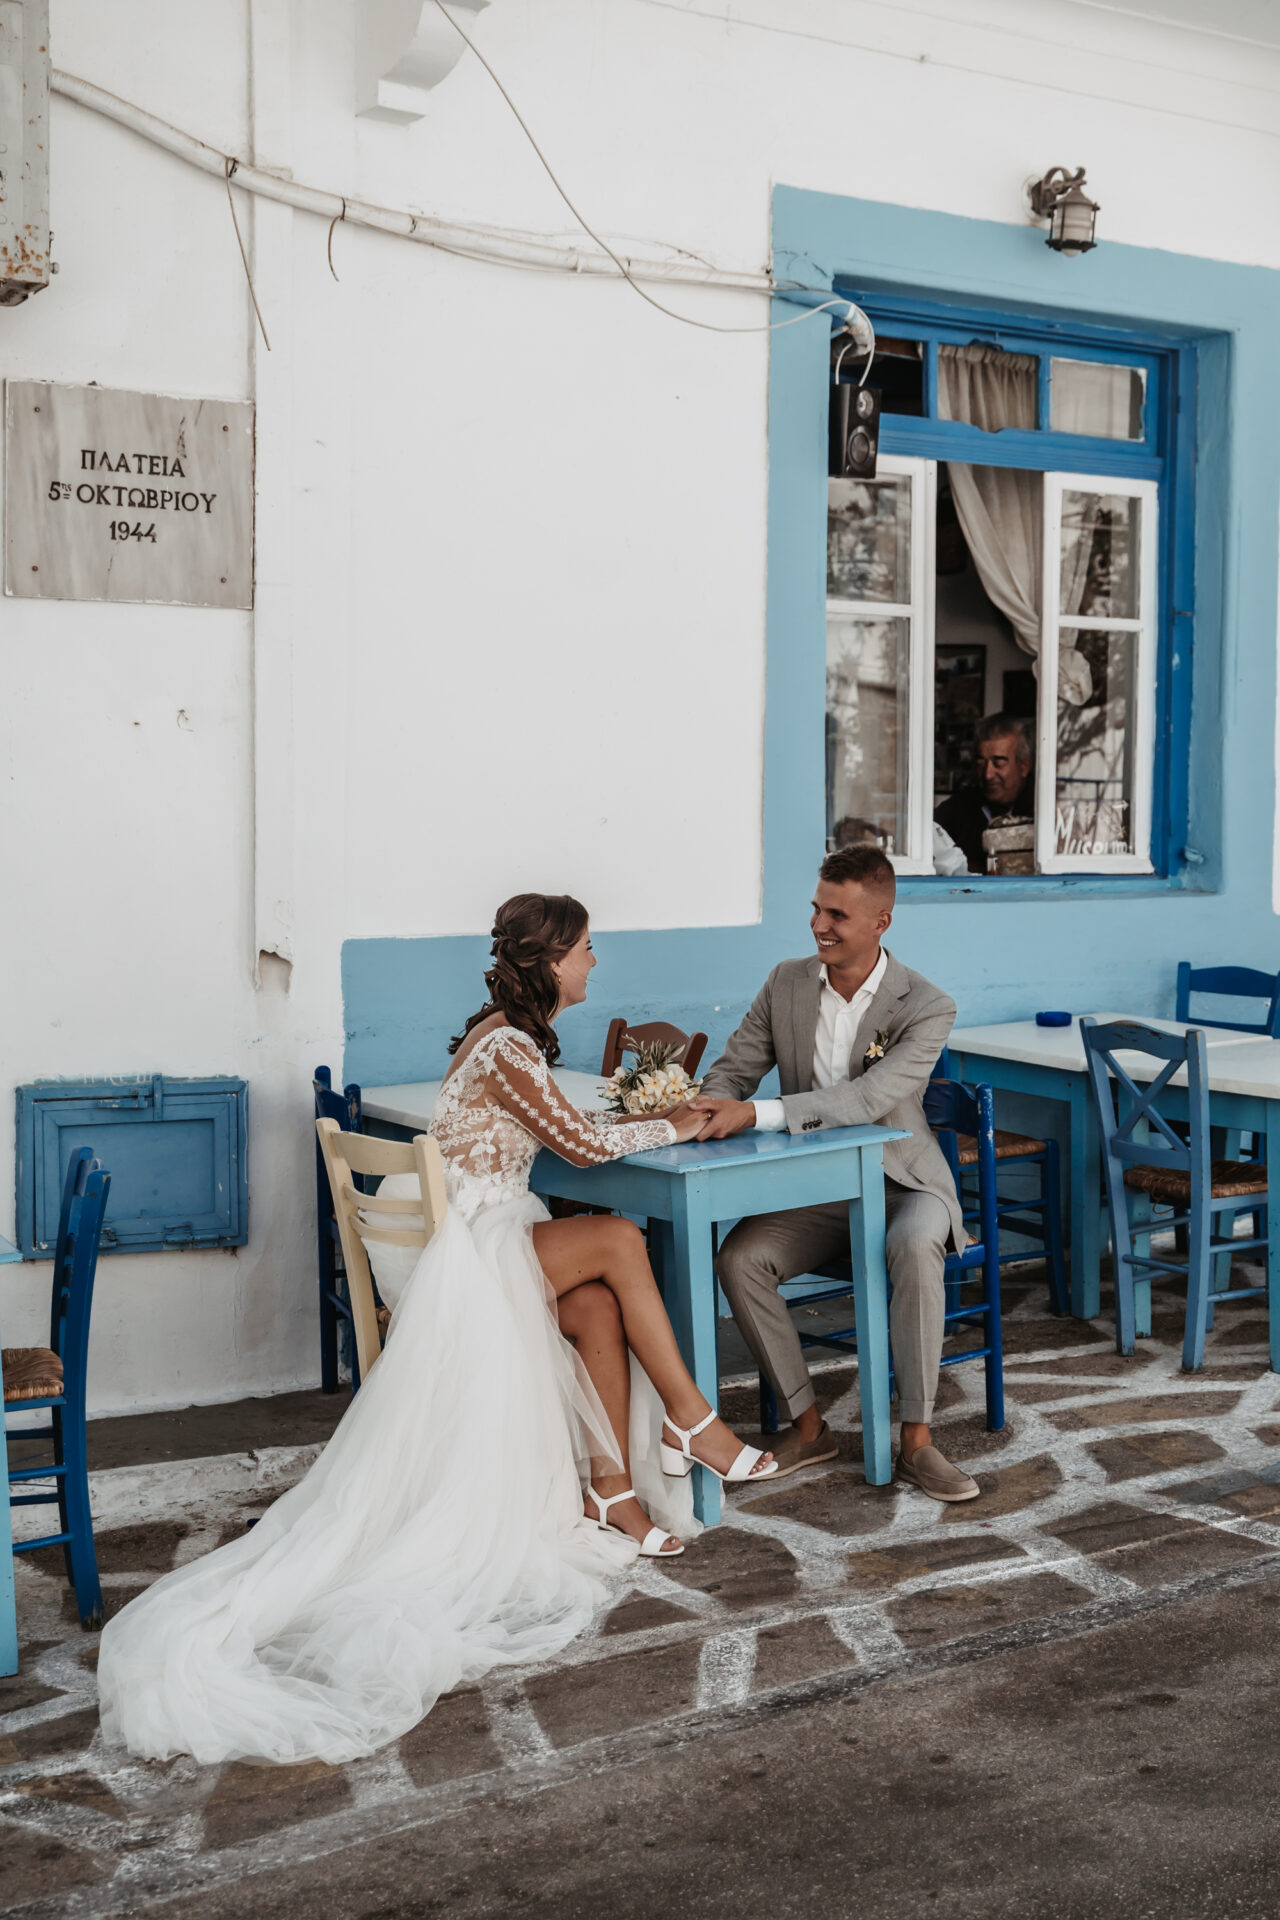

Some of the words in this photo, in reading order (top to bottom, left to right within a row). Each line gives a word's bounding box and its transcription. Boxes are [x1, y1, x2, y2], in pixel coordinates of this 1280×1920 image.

[80, 449, 186, 477] ΠΛΑΤΕΙΑ
[76, 483, 217, 513] ΟΚΤΩΒΡΙΟΥ
[109, 520, 157, 543] 1944
